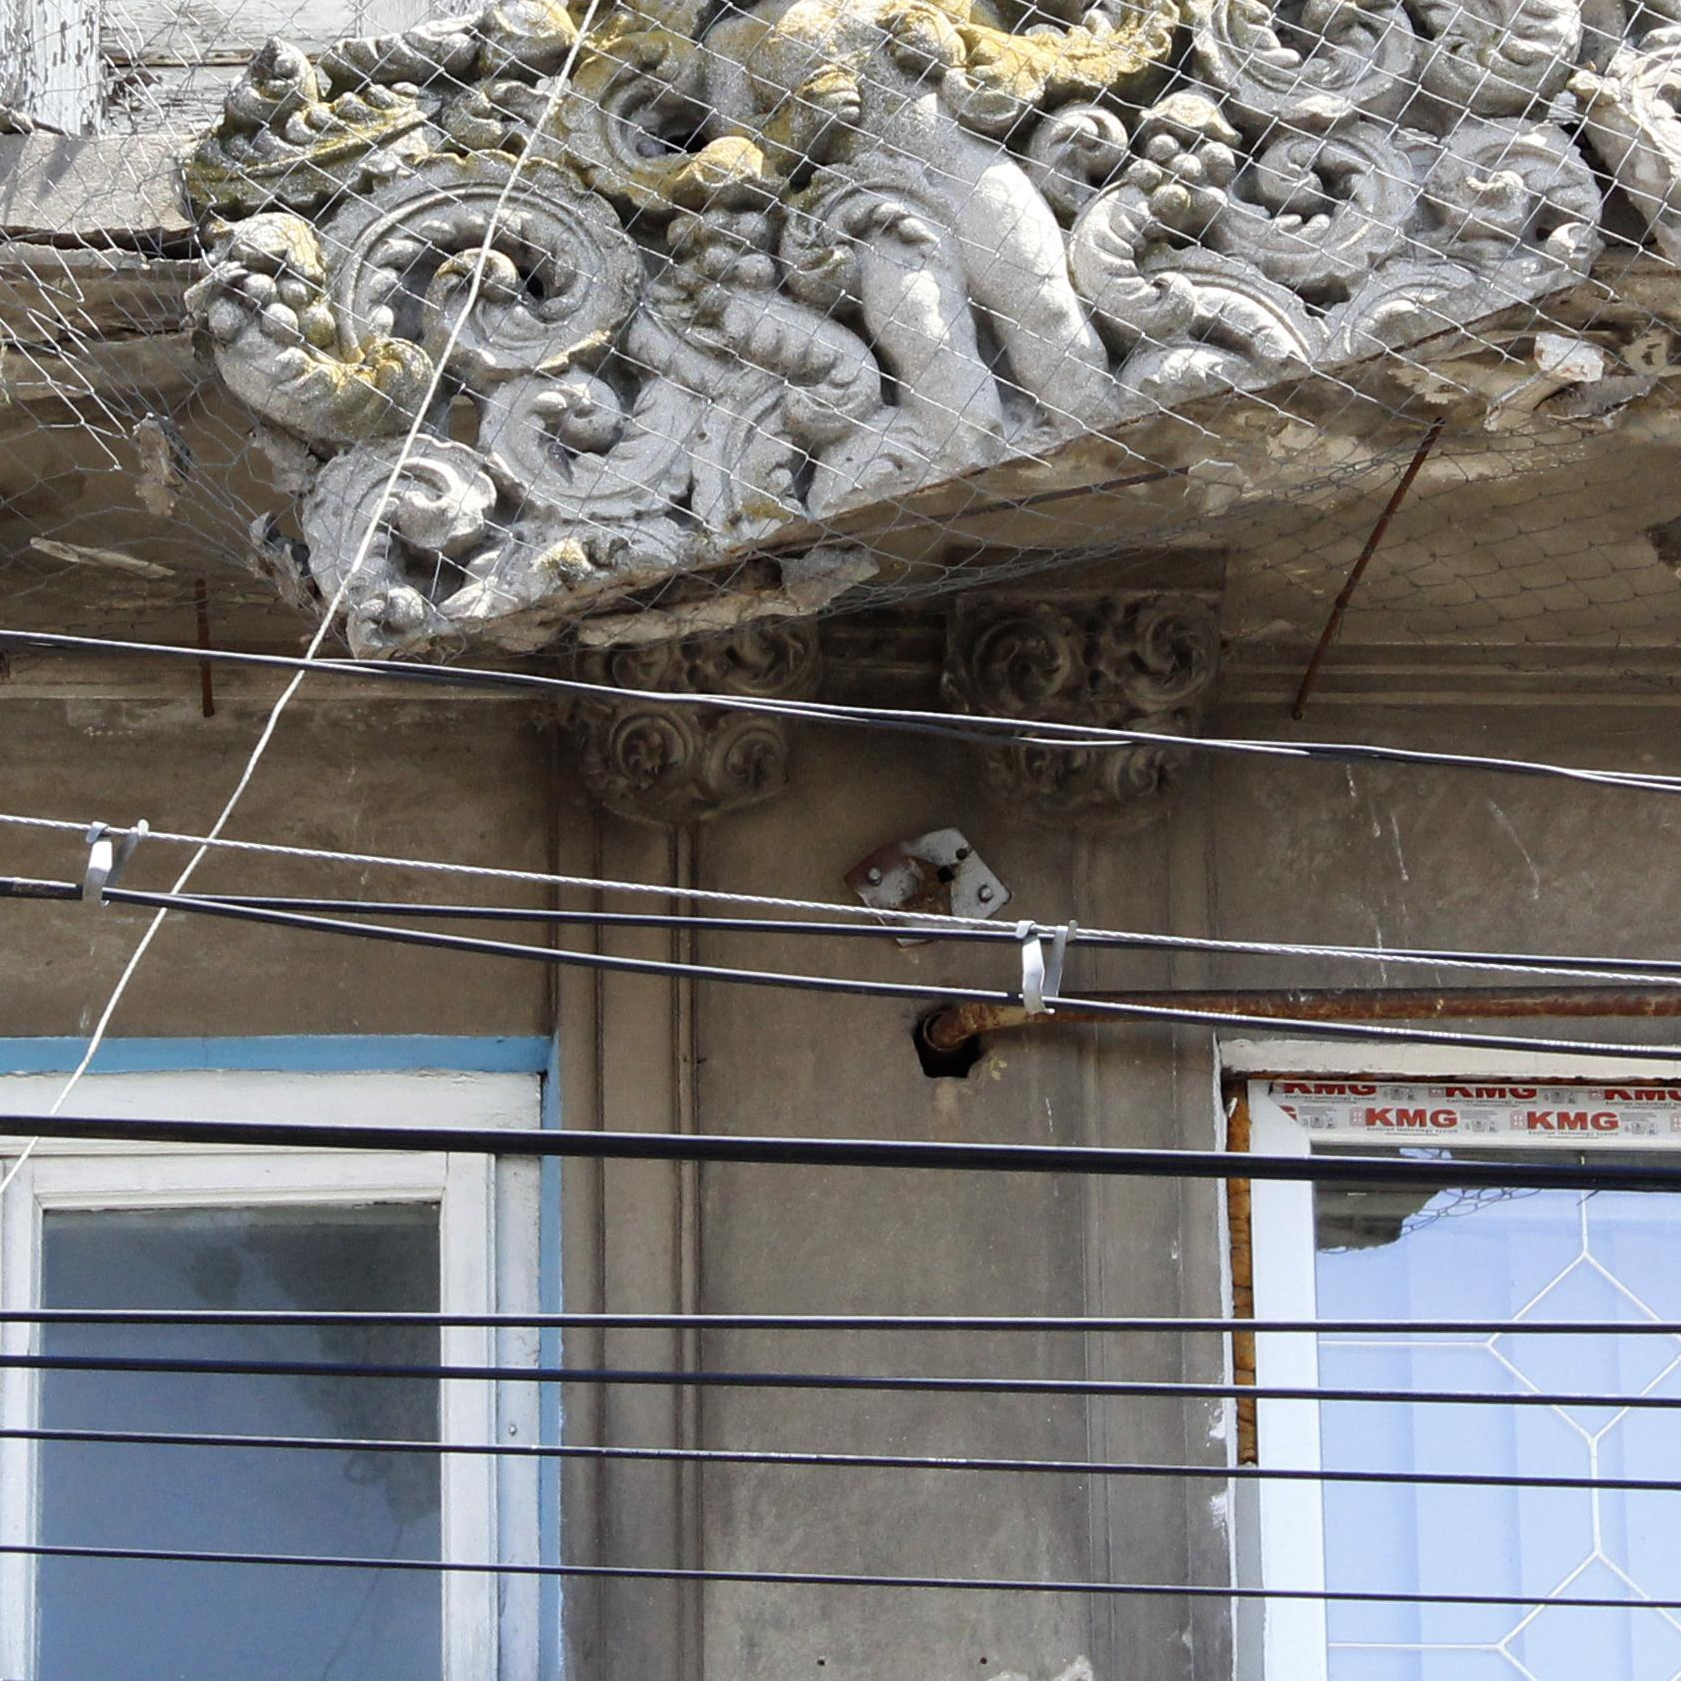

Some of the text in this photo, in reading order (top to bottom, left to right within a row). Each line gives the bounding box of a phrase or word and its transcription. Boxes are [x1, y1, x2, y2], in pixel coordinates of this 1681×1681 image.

[1284, 1082, 1376, 1095] KMG
[1445, 1087, 1537, 1099] KMG
[1365, 1108, 1458, 1127] KMG
[1527, 1111, 1620, 1130] KMG
